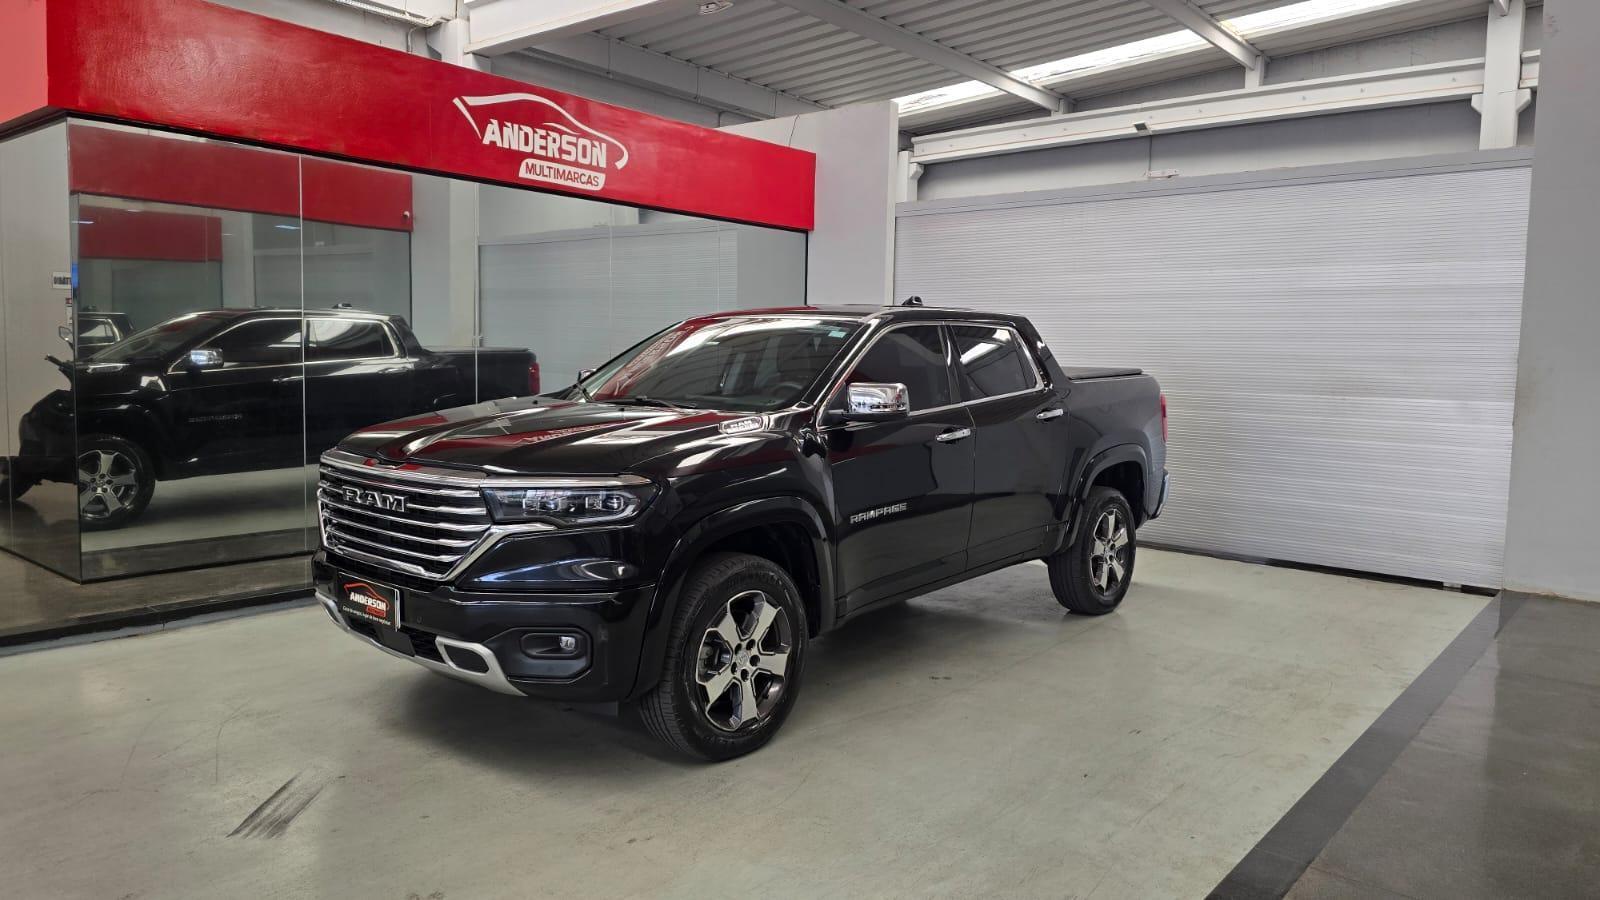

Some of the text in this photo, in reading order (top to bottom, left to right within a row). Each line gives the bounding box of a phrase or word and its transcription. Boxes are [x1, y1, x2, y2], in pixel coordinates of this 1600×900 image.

[482, 118, 607, 168] ANDERSON
[524, 161, 600, 187] MULTIMARCAS
[342, 486, 405, 513] RAM
[850, 502, 908, 524] RAMPAGE
[350, 591, 387, 612] ANDERSON
